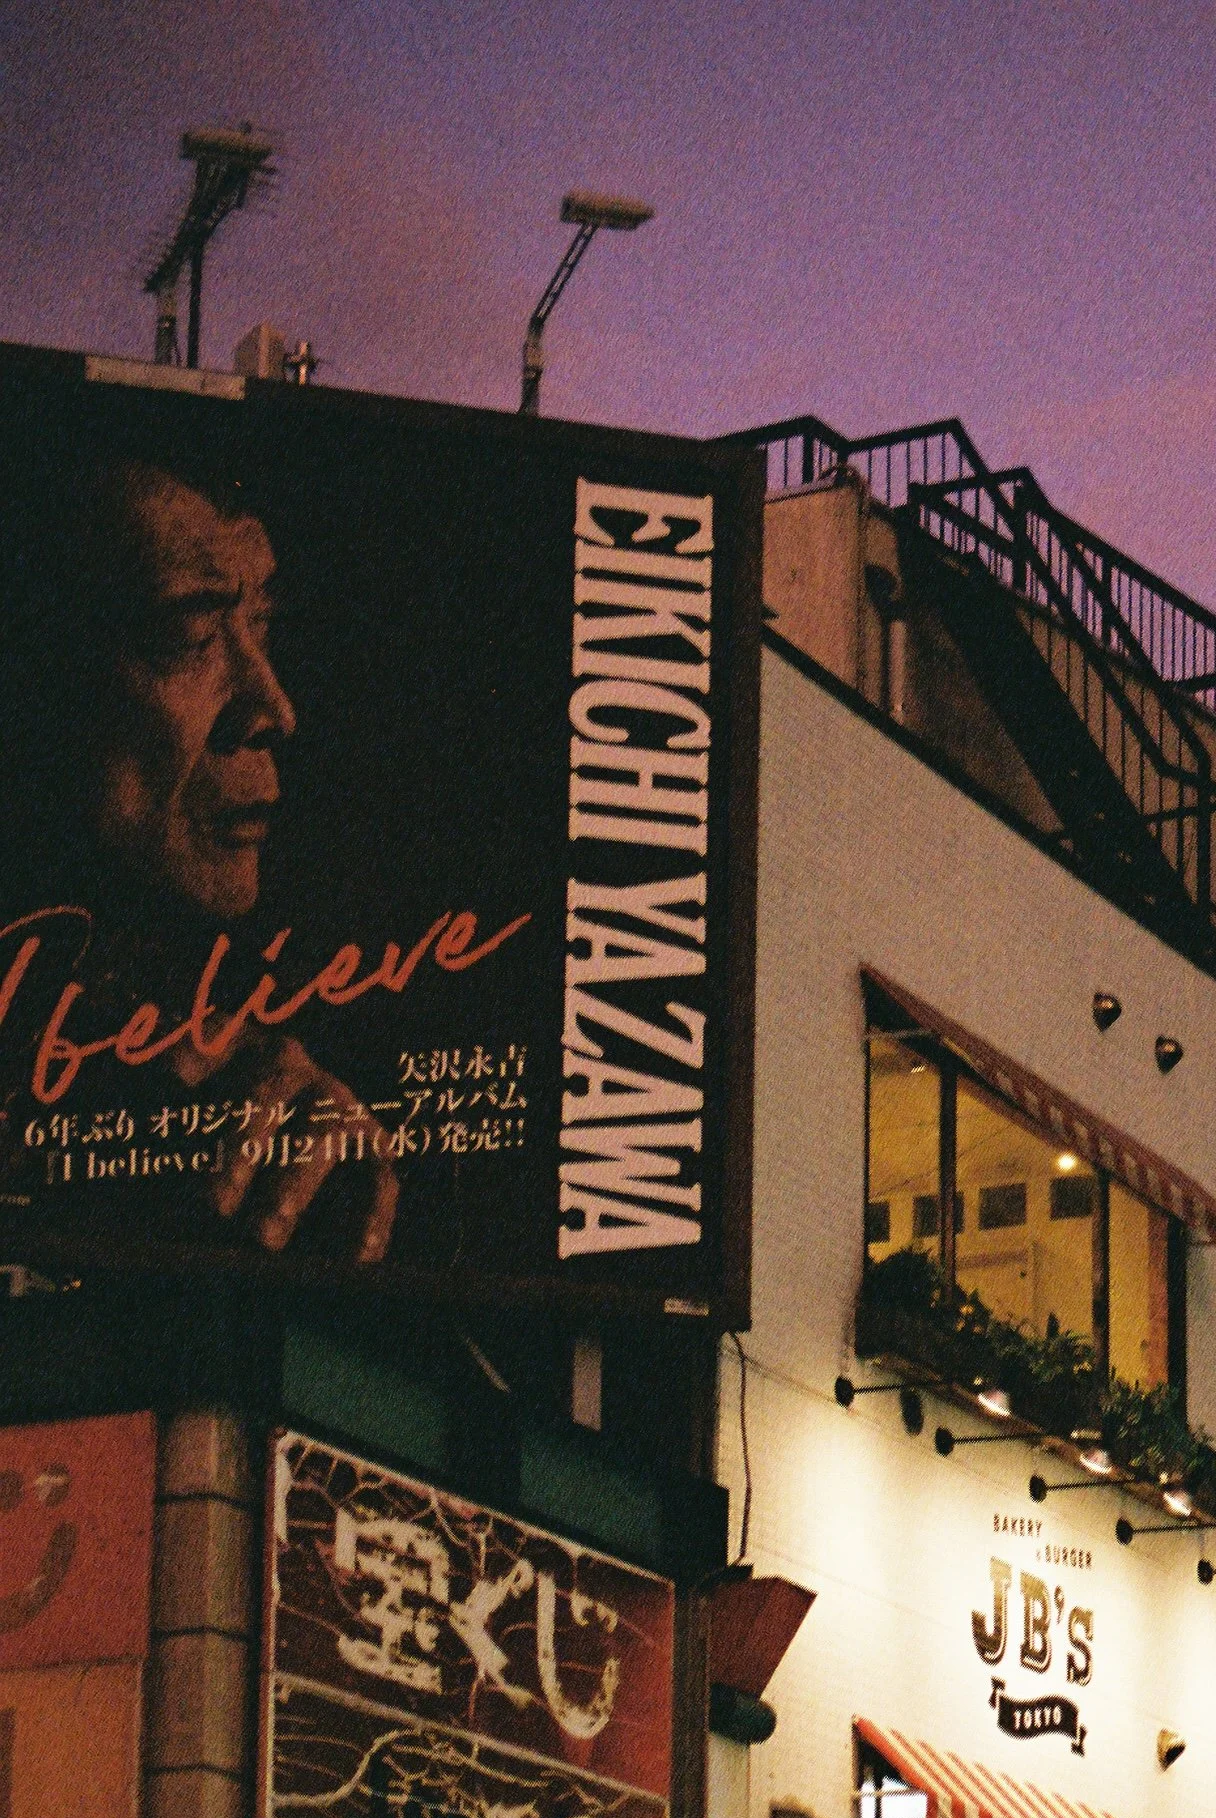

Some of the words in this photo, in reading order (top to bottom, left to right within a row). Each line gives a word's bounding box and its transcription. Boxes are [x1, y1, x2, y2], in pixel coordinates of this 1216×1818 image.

[570, 476, 714, 852] EIKICHI
[32, 911, 532, 1102] believe
[399, 1044, 528, 1084] 矢沢永吉
[558, 871, 709, 1259] YAZAWA
[24, 1107, 136, 1148] 6年ぶり
[148, 1099, 298, 1140] オリジナル
[309, 1083, 528, 1124] ニューアルバム
[994, 1514, 1042, 1537] BAKERY
[1045, 1543, 1093, 1569] BURGER
[971, 1556, 1094, 1688] JB'S
[1013, 1705, 1062, 1730] TOKYO
